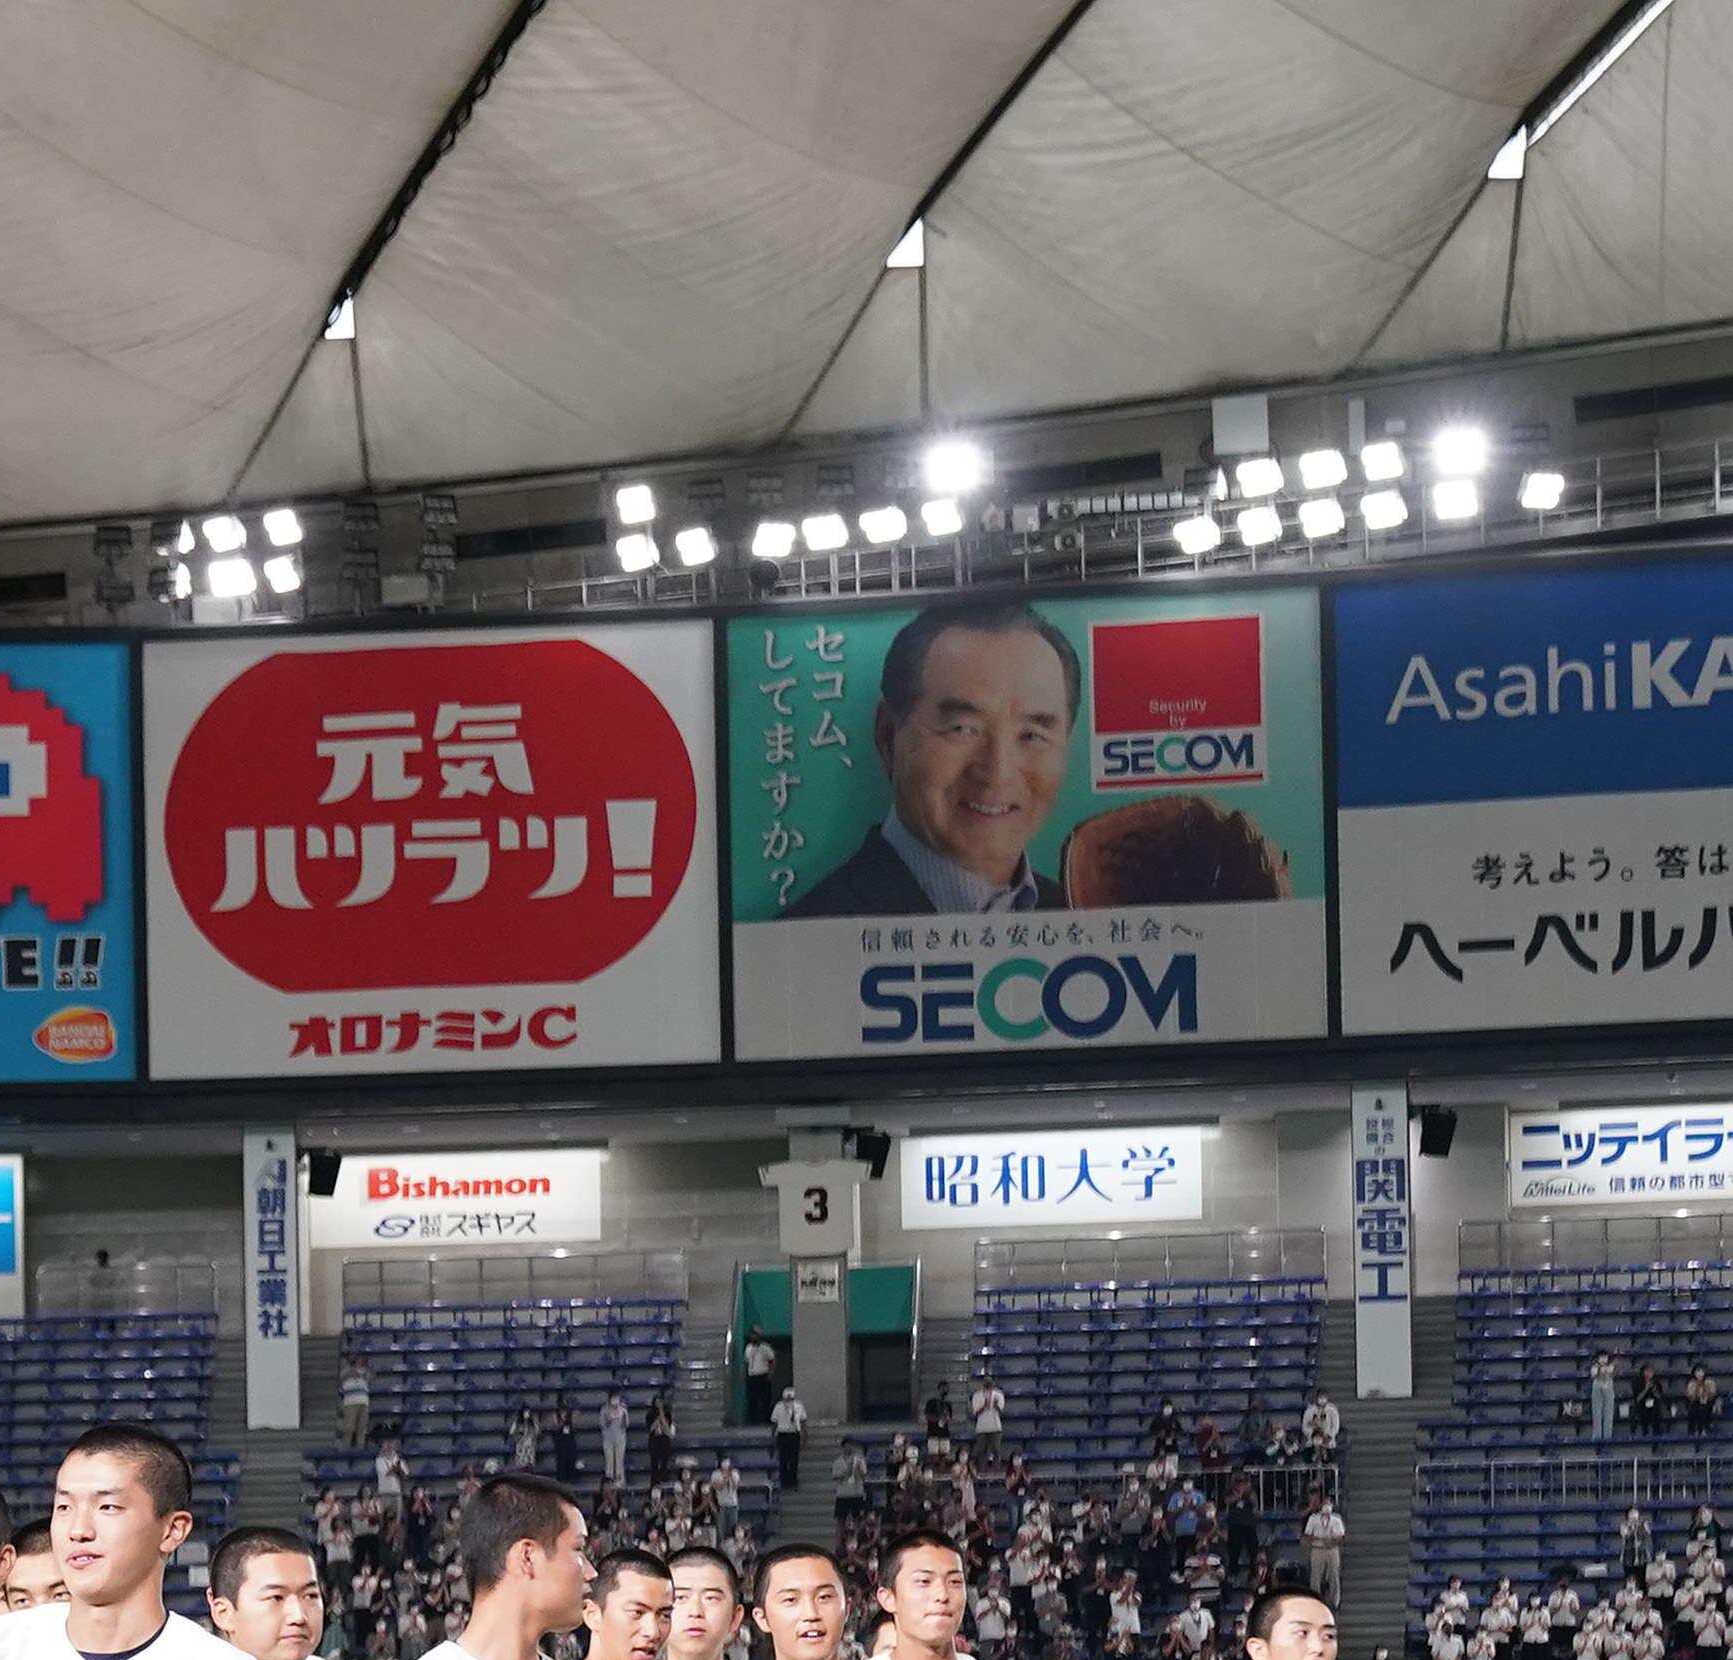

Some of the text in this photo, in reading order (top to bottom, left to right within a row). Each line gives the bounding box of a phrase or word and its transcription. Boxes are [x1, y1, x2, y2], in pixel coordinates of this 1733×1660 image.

[1149, 697, 1207, 716] Security
[316, 702, 534, 804] 元気
[758, 629, 805, 907] してますか?
[1102, 734, 1255, 776] SECOM
[210, 799, 657, 912] ハツラツ!
[860, 954, 1198, 1045] SECOM
[289, 1004, 577, 1058] オロナミンC
[1522, 1118, 1733, 1169] ニッテイラ
[368, 1167, 551, 1200] Bishamon
[925, 1145, 1178, 1208] 昭和大学
[1609, 1172, 1733, 1194] 信頼の都市型
[804, 1187, 829, 1225] 3
[257, 1187, 289, 1339] 朝日工業社
